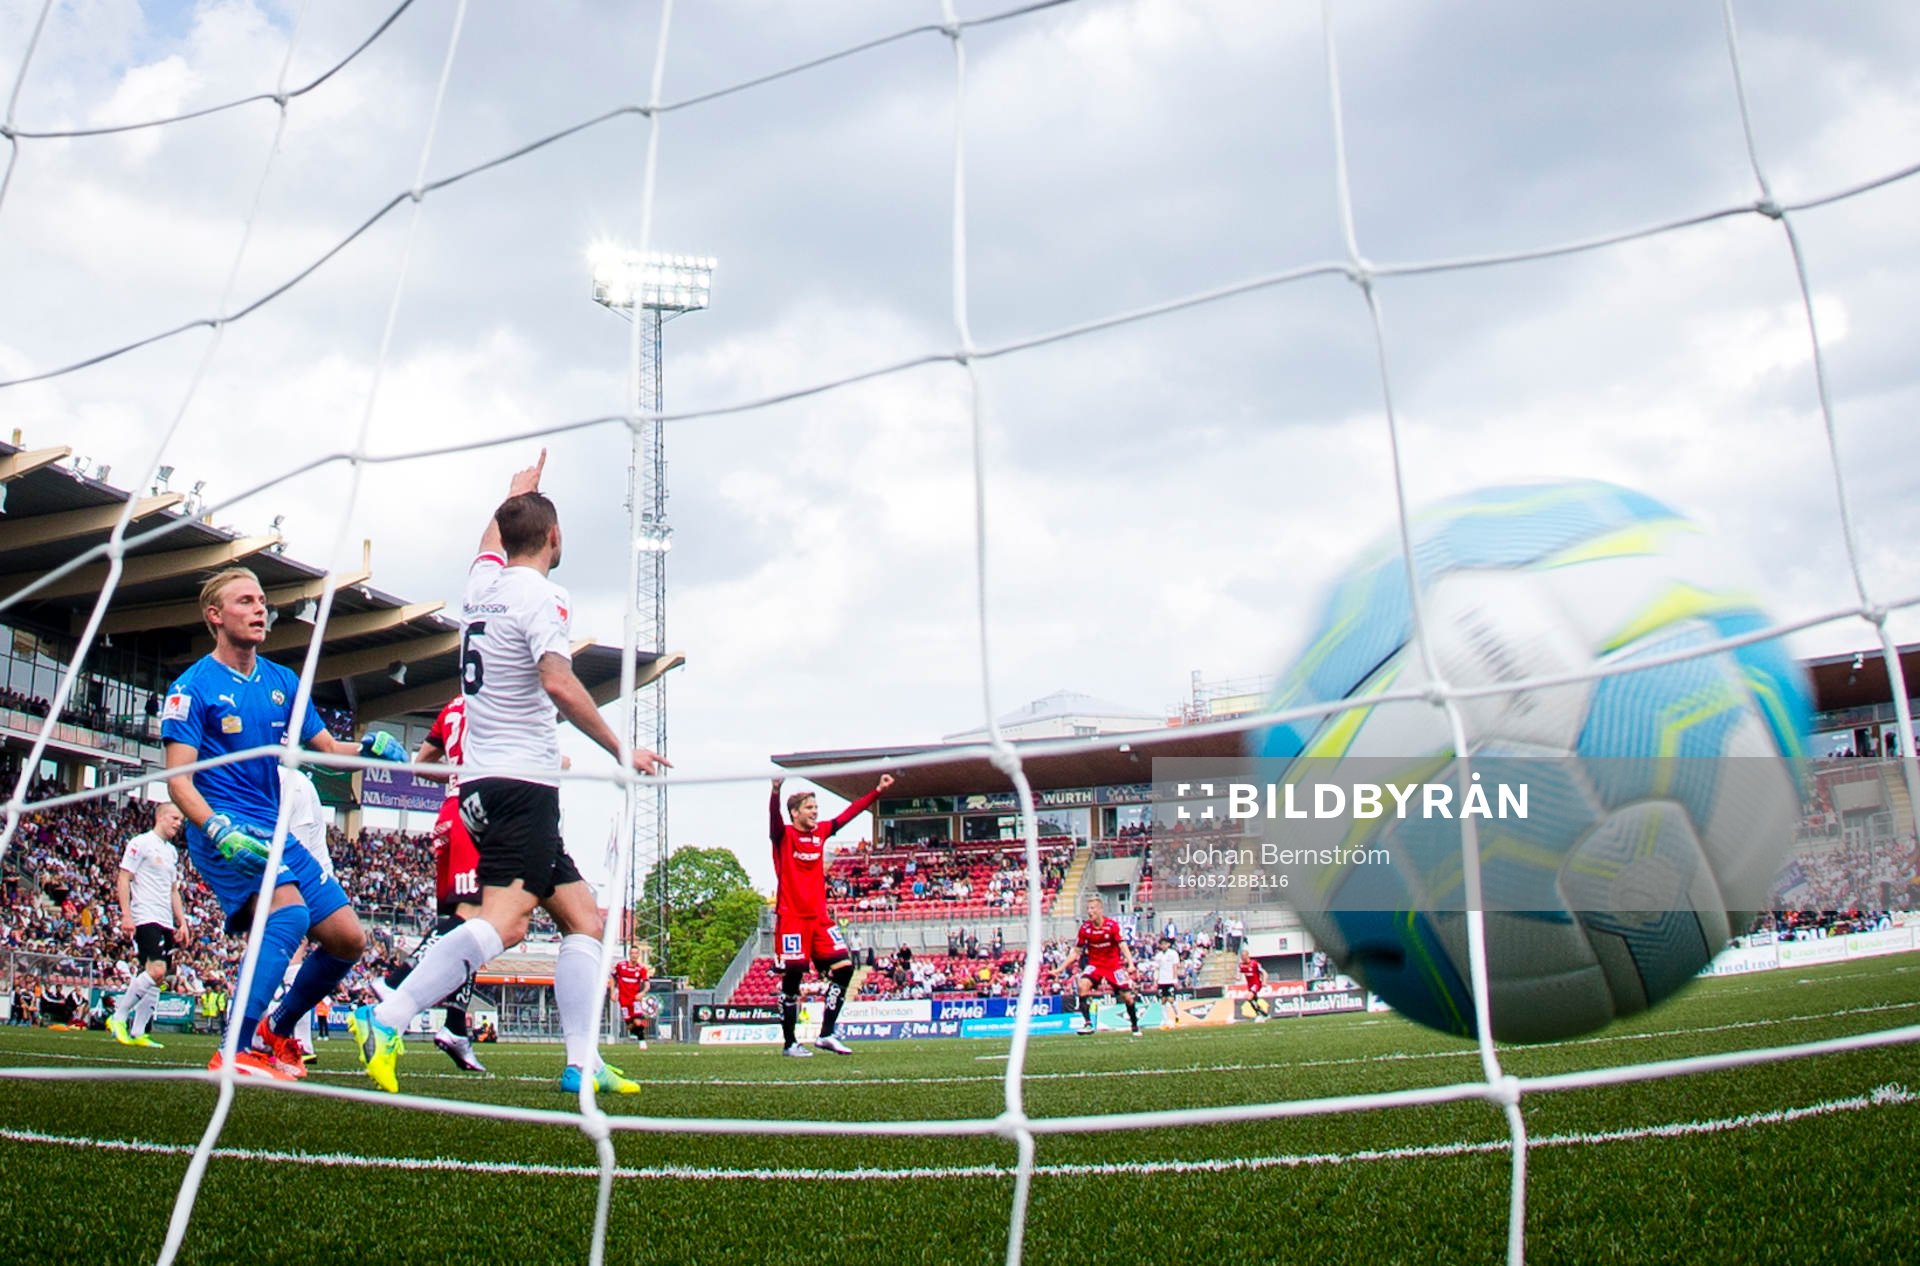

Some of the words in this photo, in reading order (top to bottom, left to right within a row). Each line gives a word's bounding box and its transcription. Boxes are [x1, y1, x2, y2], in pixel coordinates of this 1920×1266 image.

[462, 621, 486, 695] 6
[365, 767, 392, 783] NA
[1005, 1003, 1048, 1017] KMG
[1275, 993, 1362, 1013] SmålandsVillan
[842, 1006, 867, 1018] Grant
[870, 1005, 913, 1017] Thornton
[940, 1005, 983, 1019] KPMG
[726, 1028, 762, 1041] TIPS
